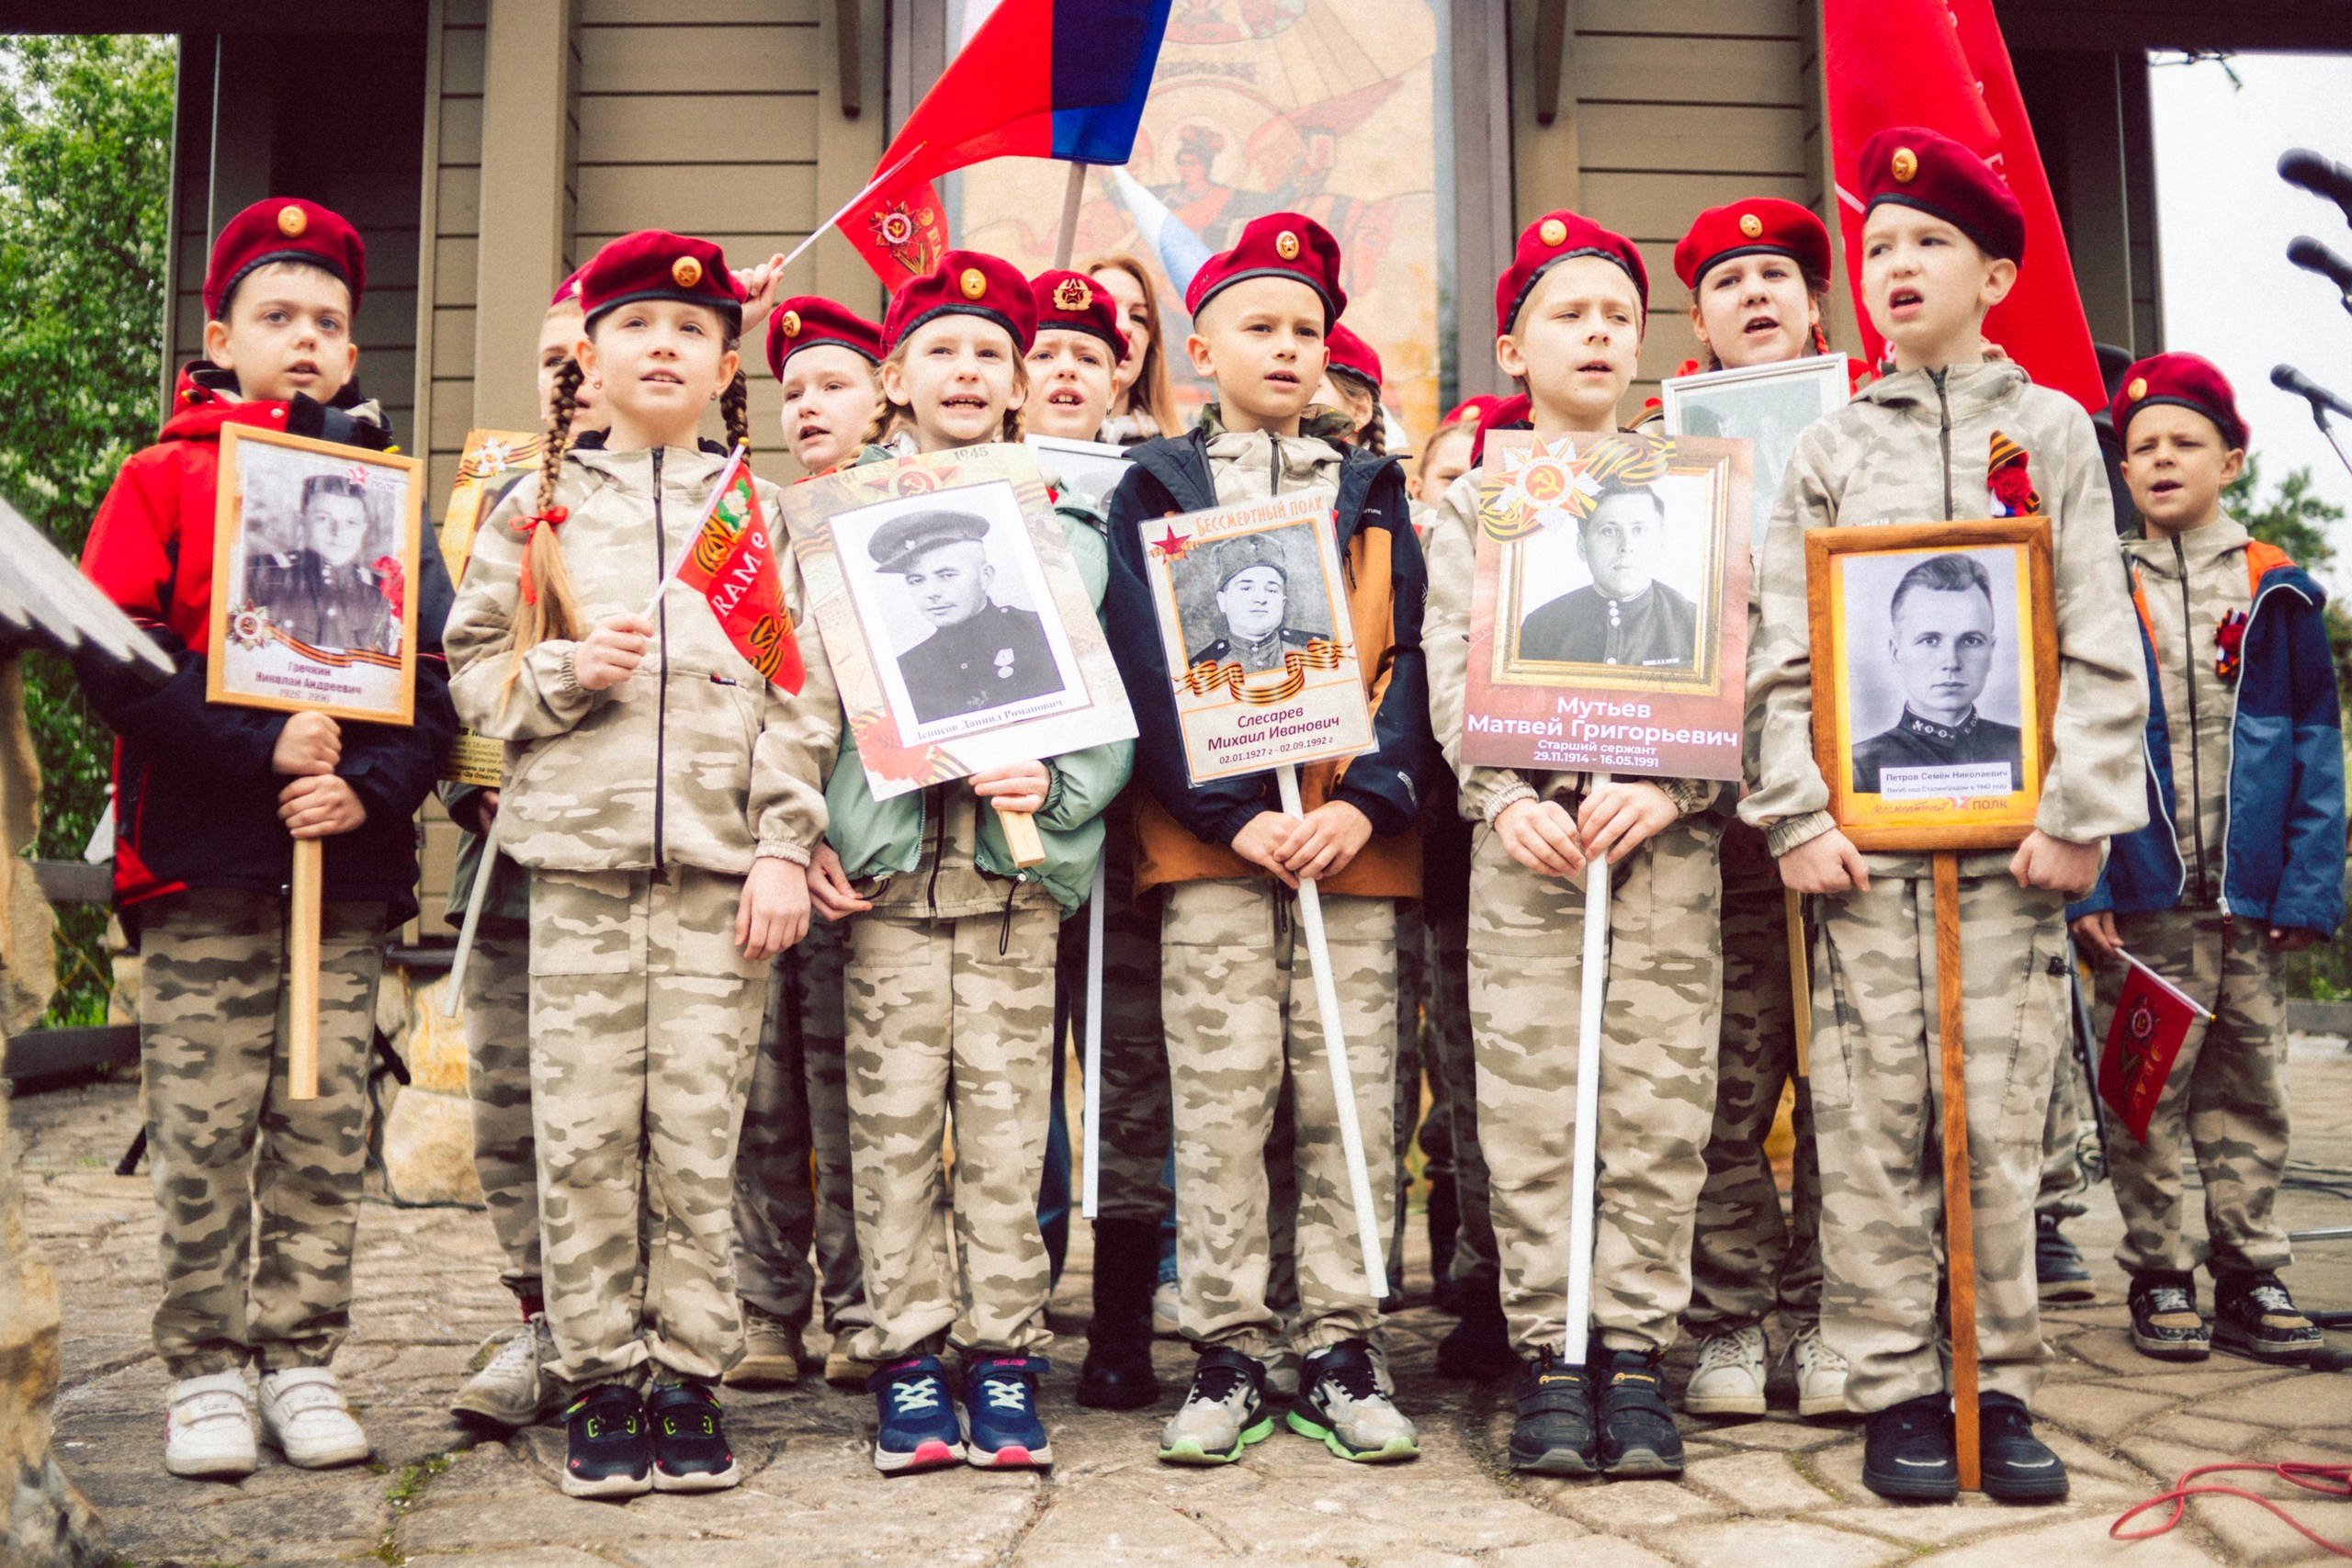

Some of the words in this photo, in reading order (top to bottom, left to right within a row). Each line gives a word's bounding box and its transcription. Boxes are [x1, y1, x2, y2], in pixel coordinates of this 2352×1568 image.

[954, 446, 989, 460] 1945
[288, 661, 331, 676] Гречкин
[303, 678, 362, 694] Андреевич
[1004, 699, 1063, 720] Романович
[1556, 696, 1651, 718] Мутьев
[1238, 706, 1304, 728] Слесарев
[1207, 731, 1265, 751] Михаил
[1270, 716, 1340, 739] Иванович
[1467, 714, 1563, 737] Матвей
[1570, 719, 1738, 747] Григорьевич
[1219, 748, 1266, 764] 02.01.1927
[1280, 737, 1327, 753] 02.09.1992
[1538, 739, 1597, 752] Старший
[1600, 743, 1657, 756] сержант
[1533, 750, 1589, 764] 29.11.1914
[1600, 754, 1659, 768] 16.05.1991
[1886, 773, 1918, 782] Петров
[1921, 772, 1950, 780] Семён
[1952, 771, 2007, 779] Николаевич
[1973, 799, 2007, 810] ПОЛК
